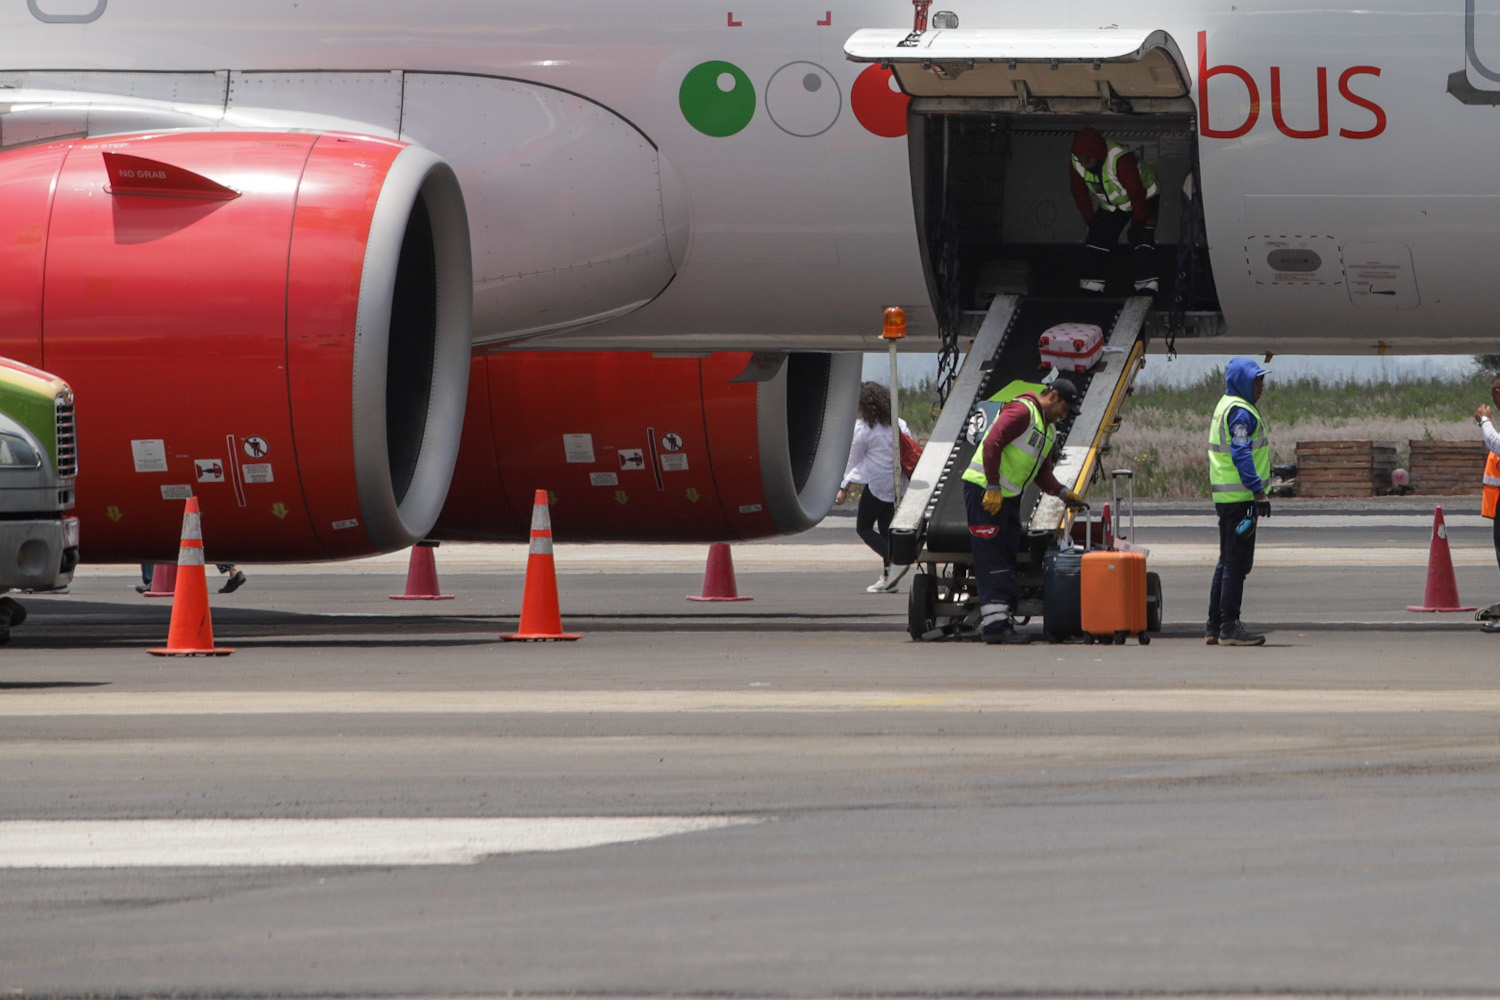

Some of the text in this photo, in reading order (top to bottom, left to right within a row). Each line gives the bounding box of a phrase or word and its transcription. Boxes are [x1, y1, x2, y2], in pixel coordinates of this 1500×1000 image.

[1198, 30, 1387, 140] bus
[118, 169, 166, 179] NO GRAB
